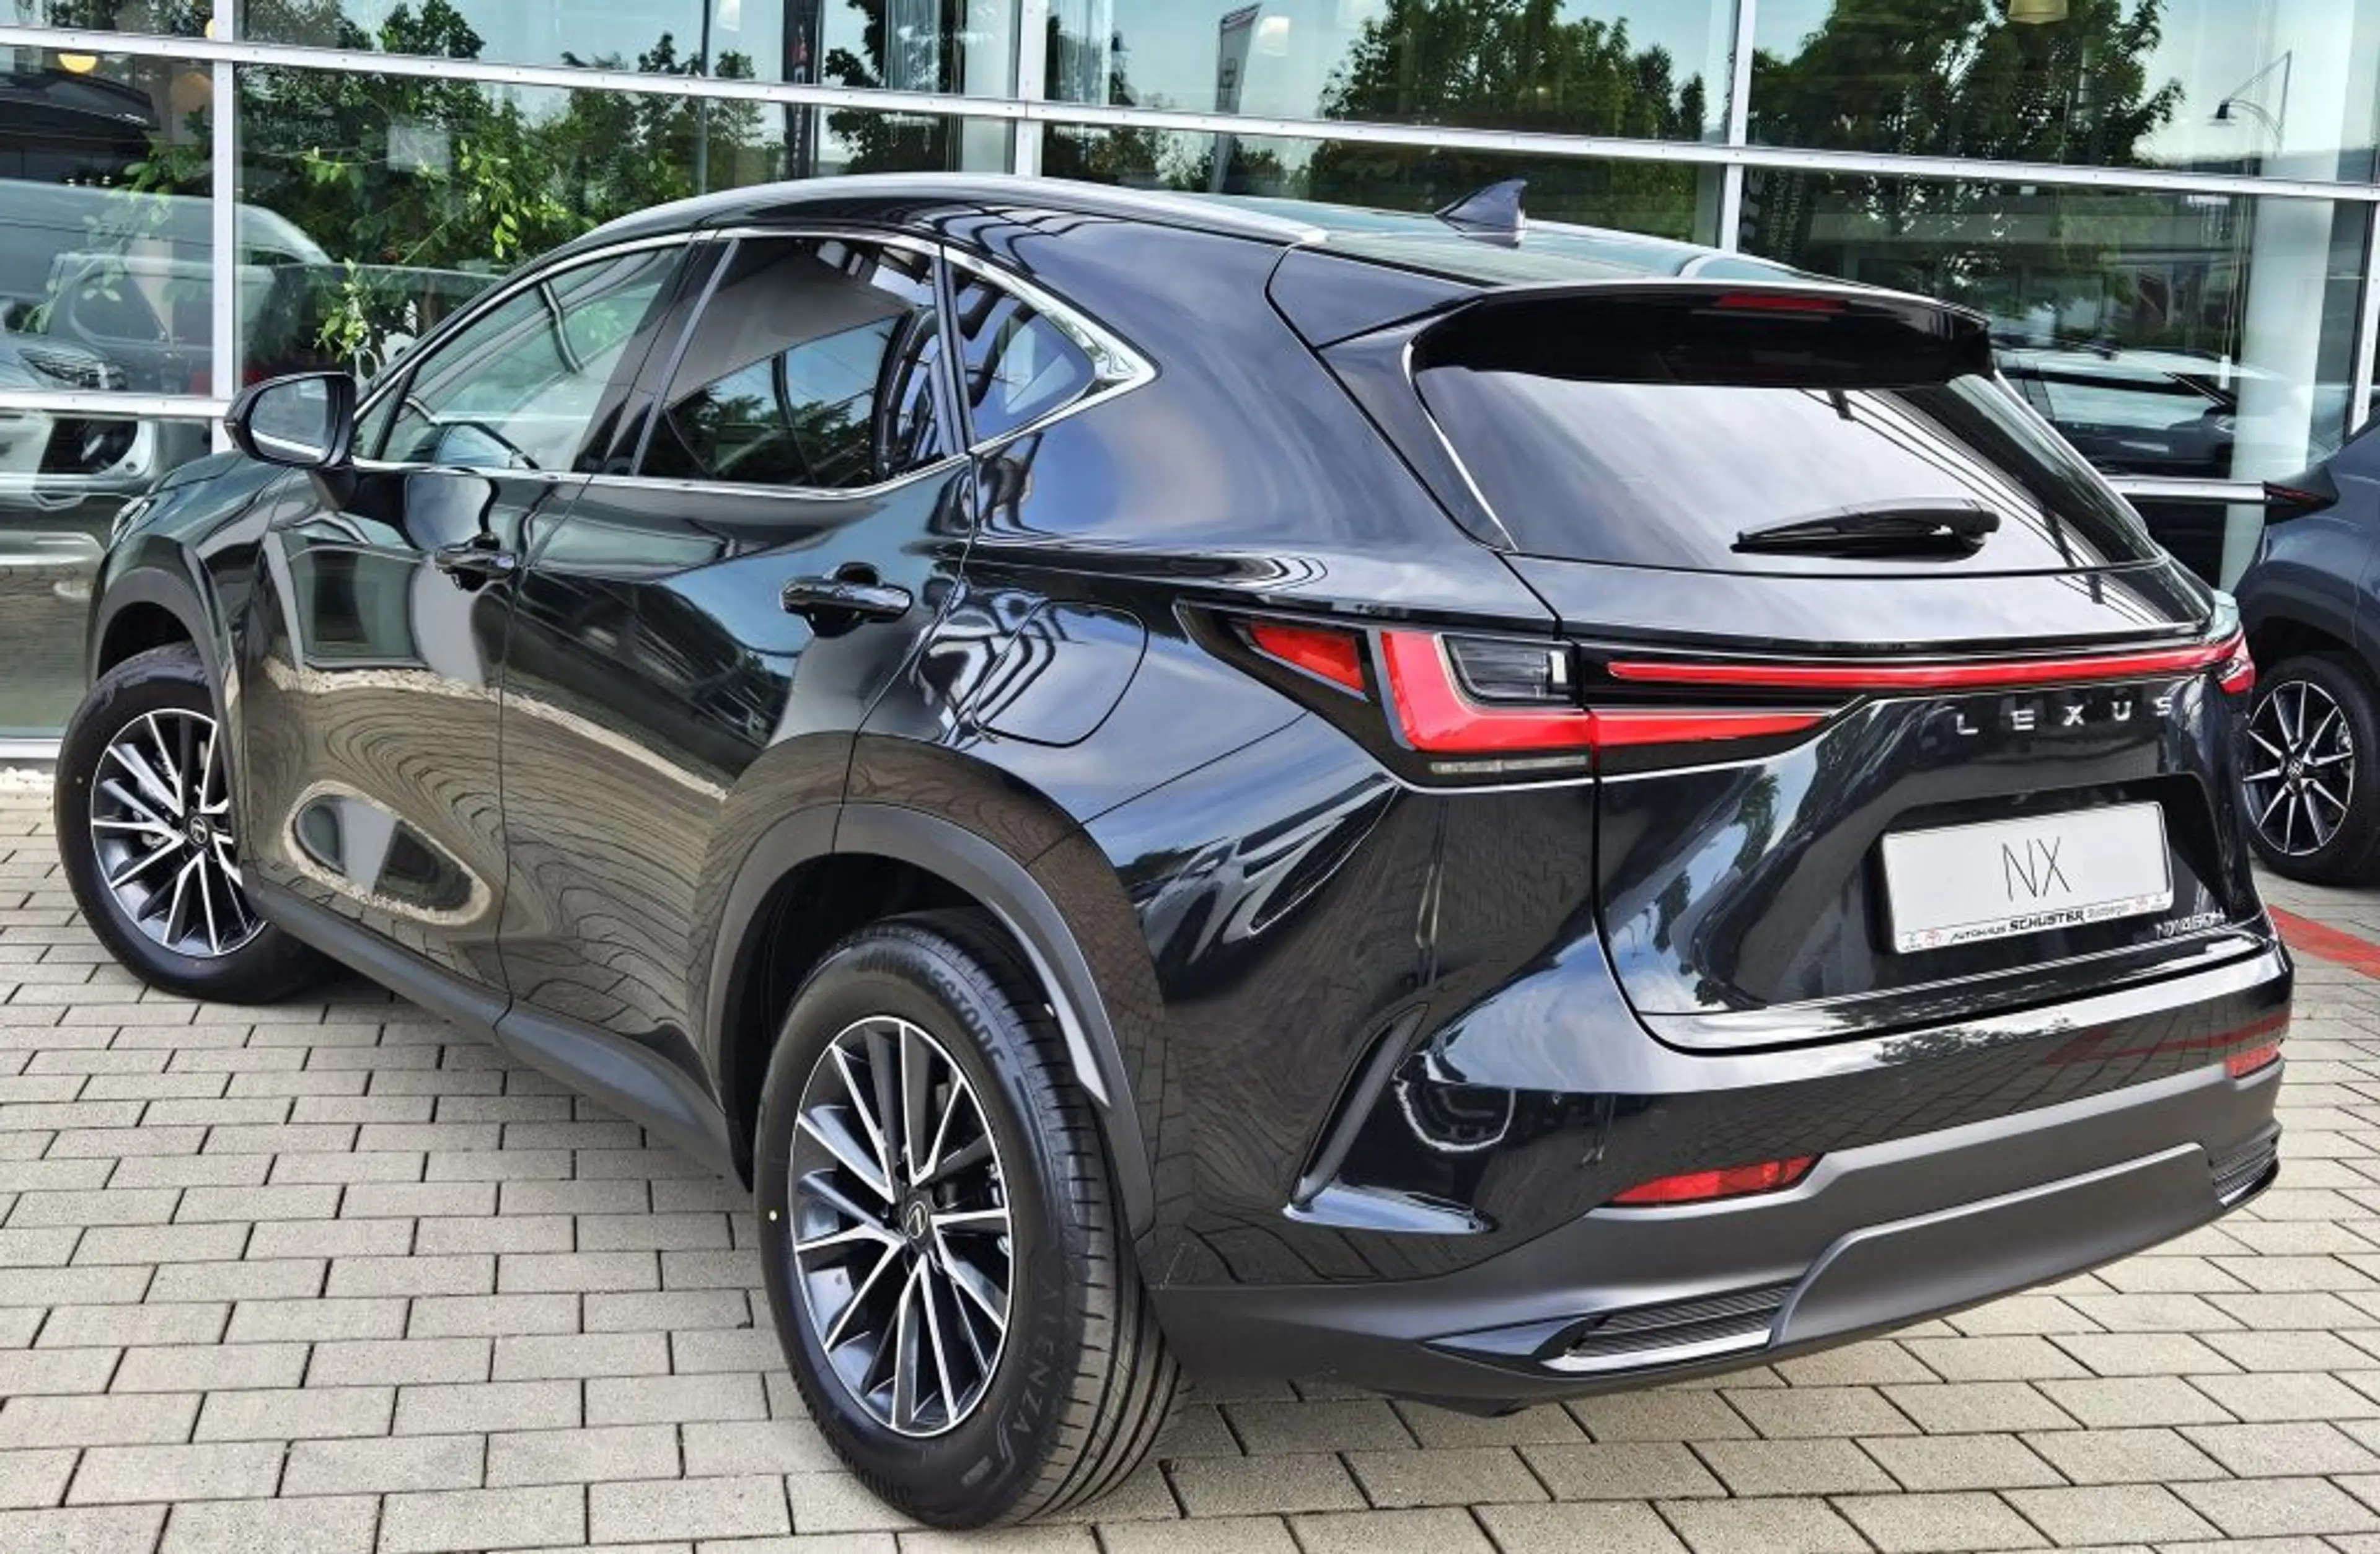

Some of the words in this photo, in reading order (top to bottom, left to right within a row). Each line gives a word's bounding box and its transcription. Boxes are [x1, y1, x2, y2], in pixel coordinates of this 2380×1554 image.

[1956, 696, 2172, 735] LEXUS
[2002, 835, 2071, 902] NX
[2009, 909, 2084, 931] SCHUSTER
